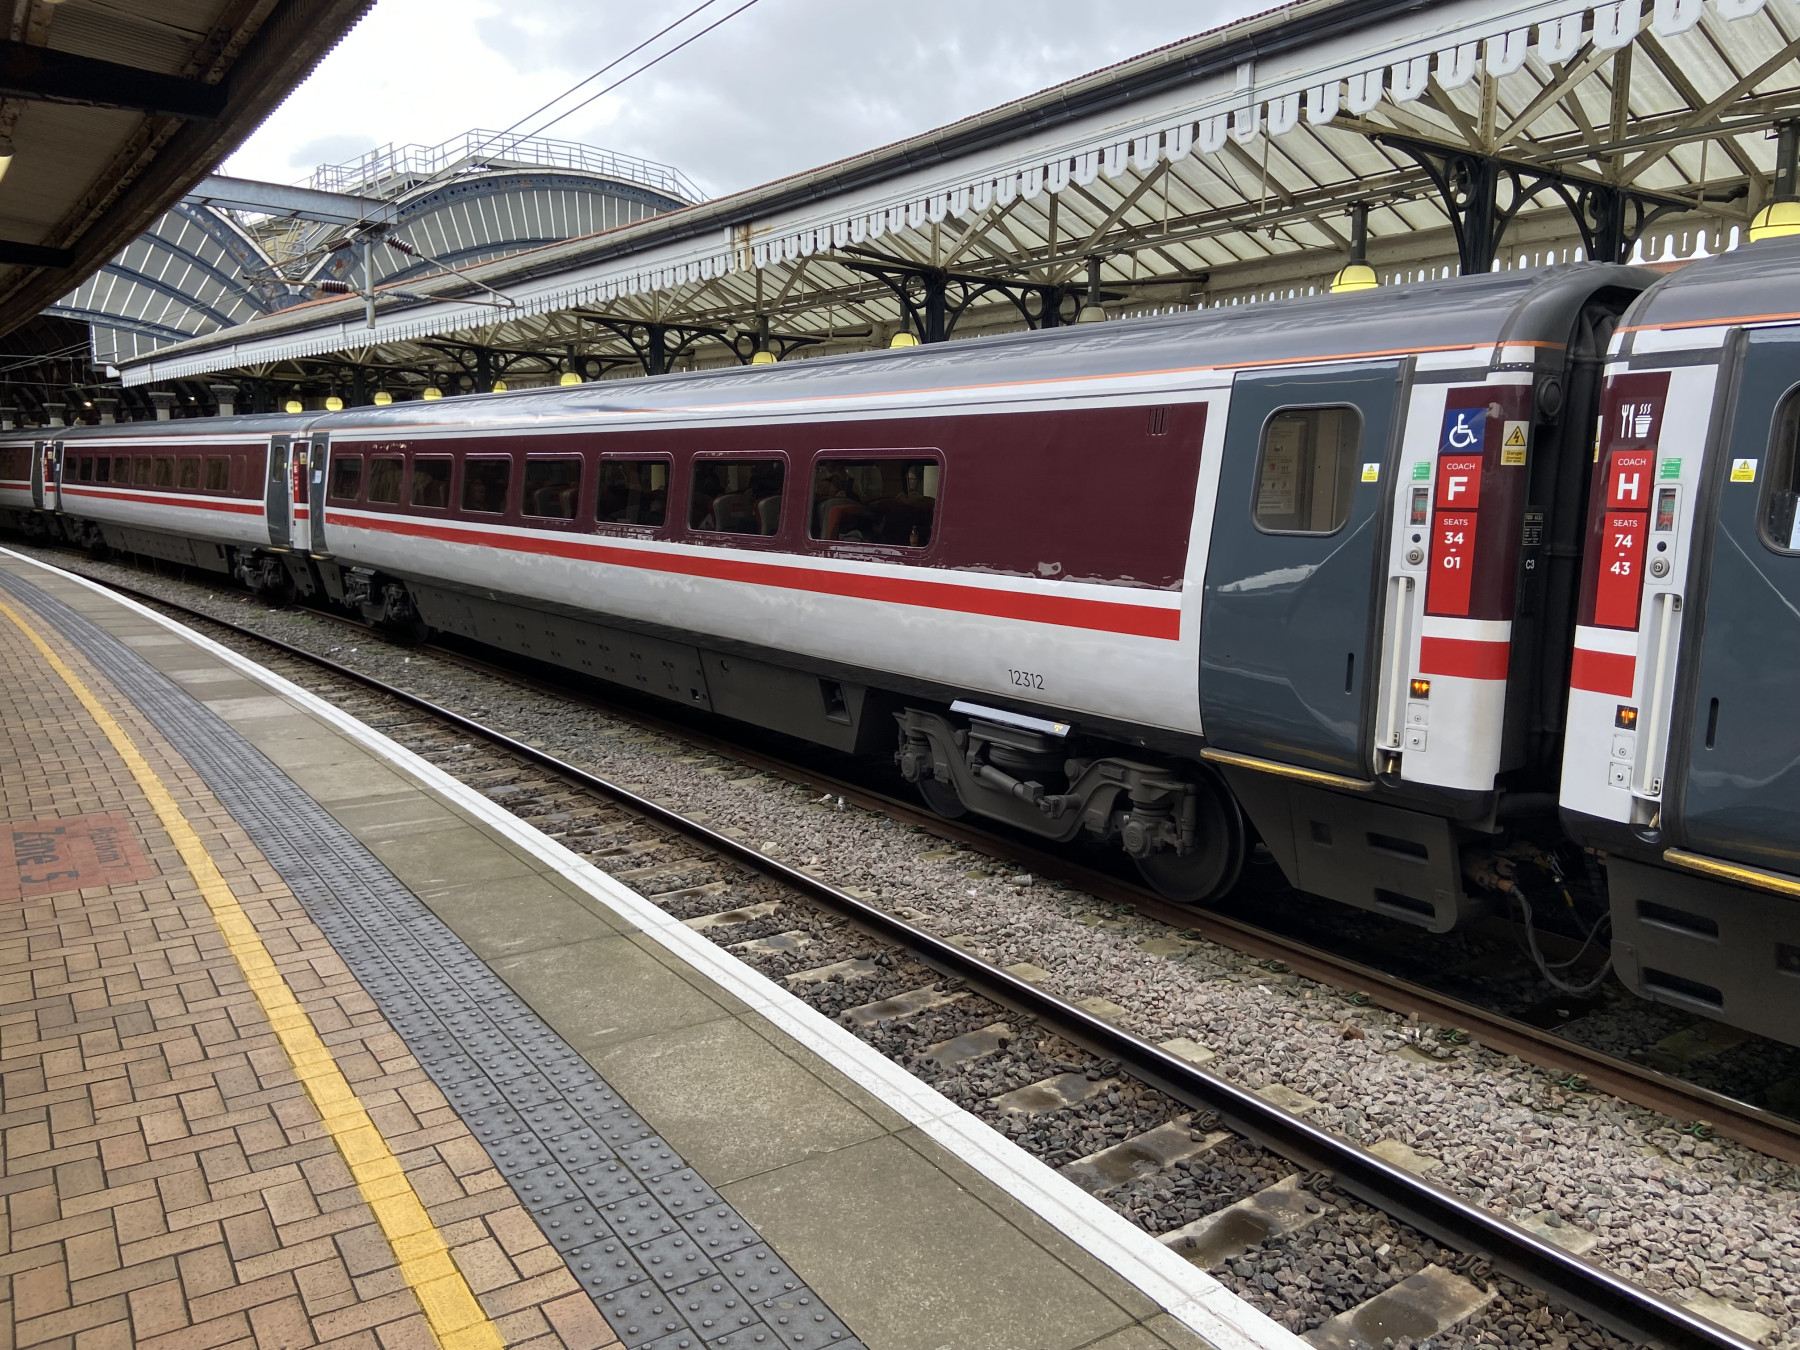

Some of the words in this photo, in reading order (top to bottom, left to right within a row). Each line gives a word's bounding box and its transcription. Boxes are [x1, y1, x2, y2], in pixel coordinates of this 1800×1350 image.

[1446, 462, 1476, 470] COACH
[1617, 458, 1647, 466] COACH
[1447, 476, 1468, 501] F
[1616, 473, 1640, 500] H
[1443, 518, 1469, 526] SEATS
[1613, 519, 1638, 527] SEATS
[1444, 531, 1464, 545] 34
[1614, 534, 1633, 548] 74
[1443, 556, 1461, 569] 01
[1610, 561, 1631, 576] 43
[1008, 669, 1045, 690] 12312
[13, 826, 66, 867] Zone
[20, 870, 80, 884] 5
